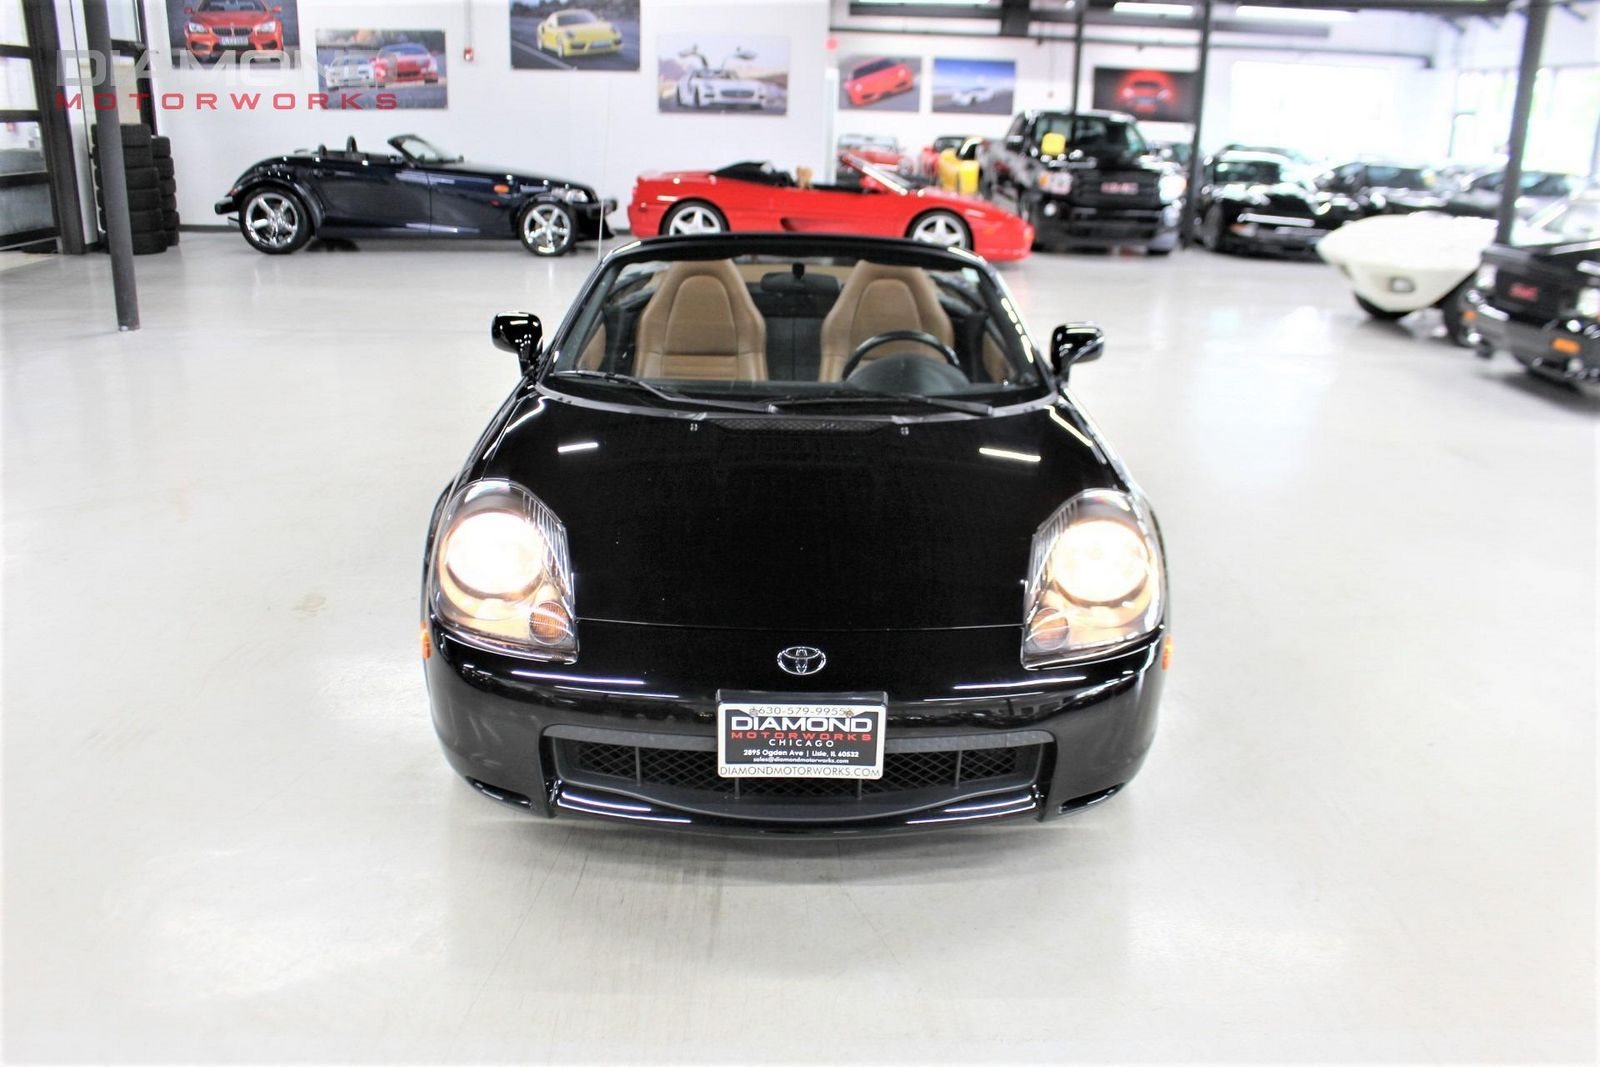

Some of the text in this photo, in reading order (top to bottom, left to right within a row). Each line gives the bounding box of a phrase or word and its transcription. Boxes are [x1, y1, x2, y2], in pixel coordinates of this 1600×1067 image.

[732, 717, 873, 732] DIAMOND
[731, 731, 872, 742] MOTORWORKS
[768, 739, 835, 748] CHICAGO
[762, 749, 788, 757] Ogden
[789, 749, 804, 757] Ave
[753, 756, 849, 764] sales@diamondmotorworks.com
[720, 767, 880, 777] DIAMONDMOTORWORKS.COM
